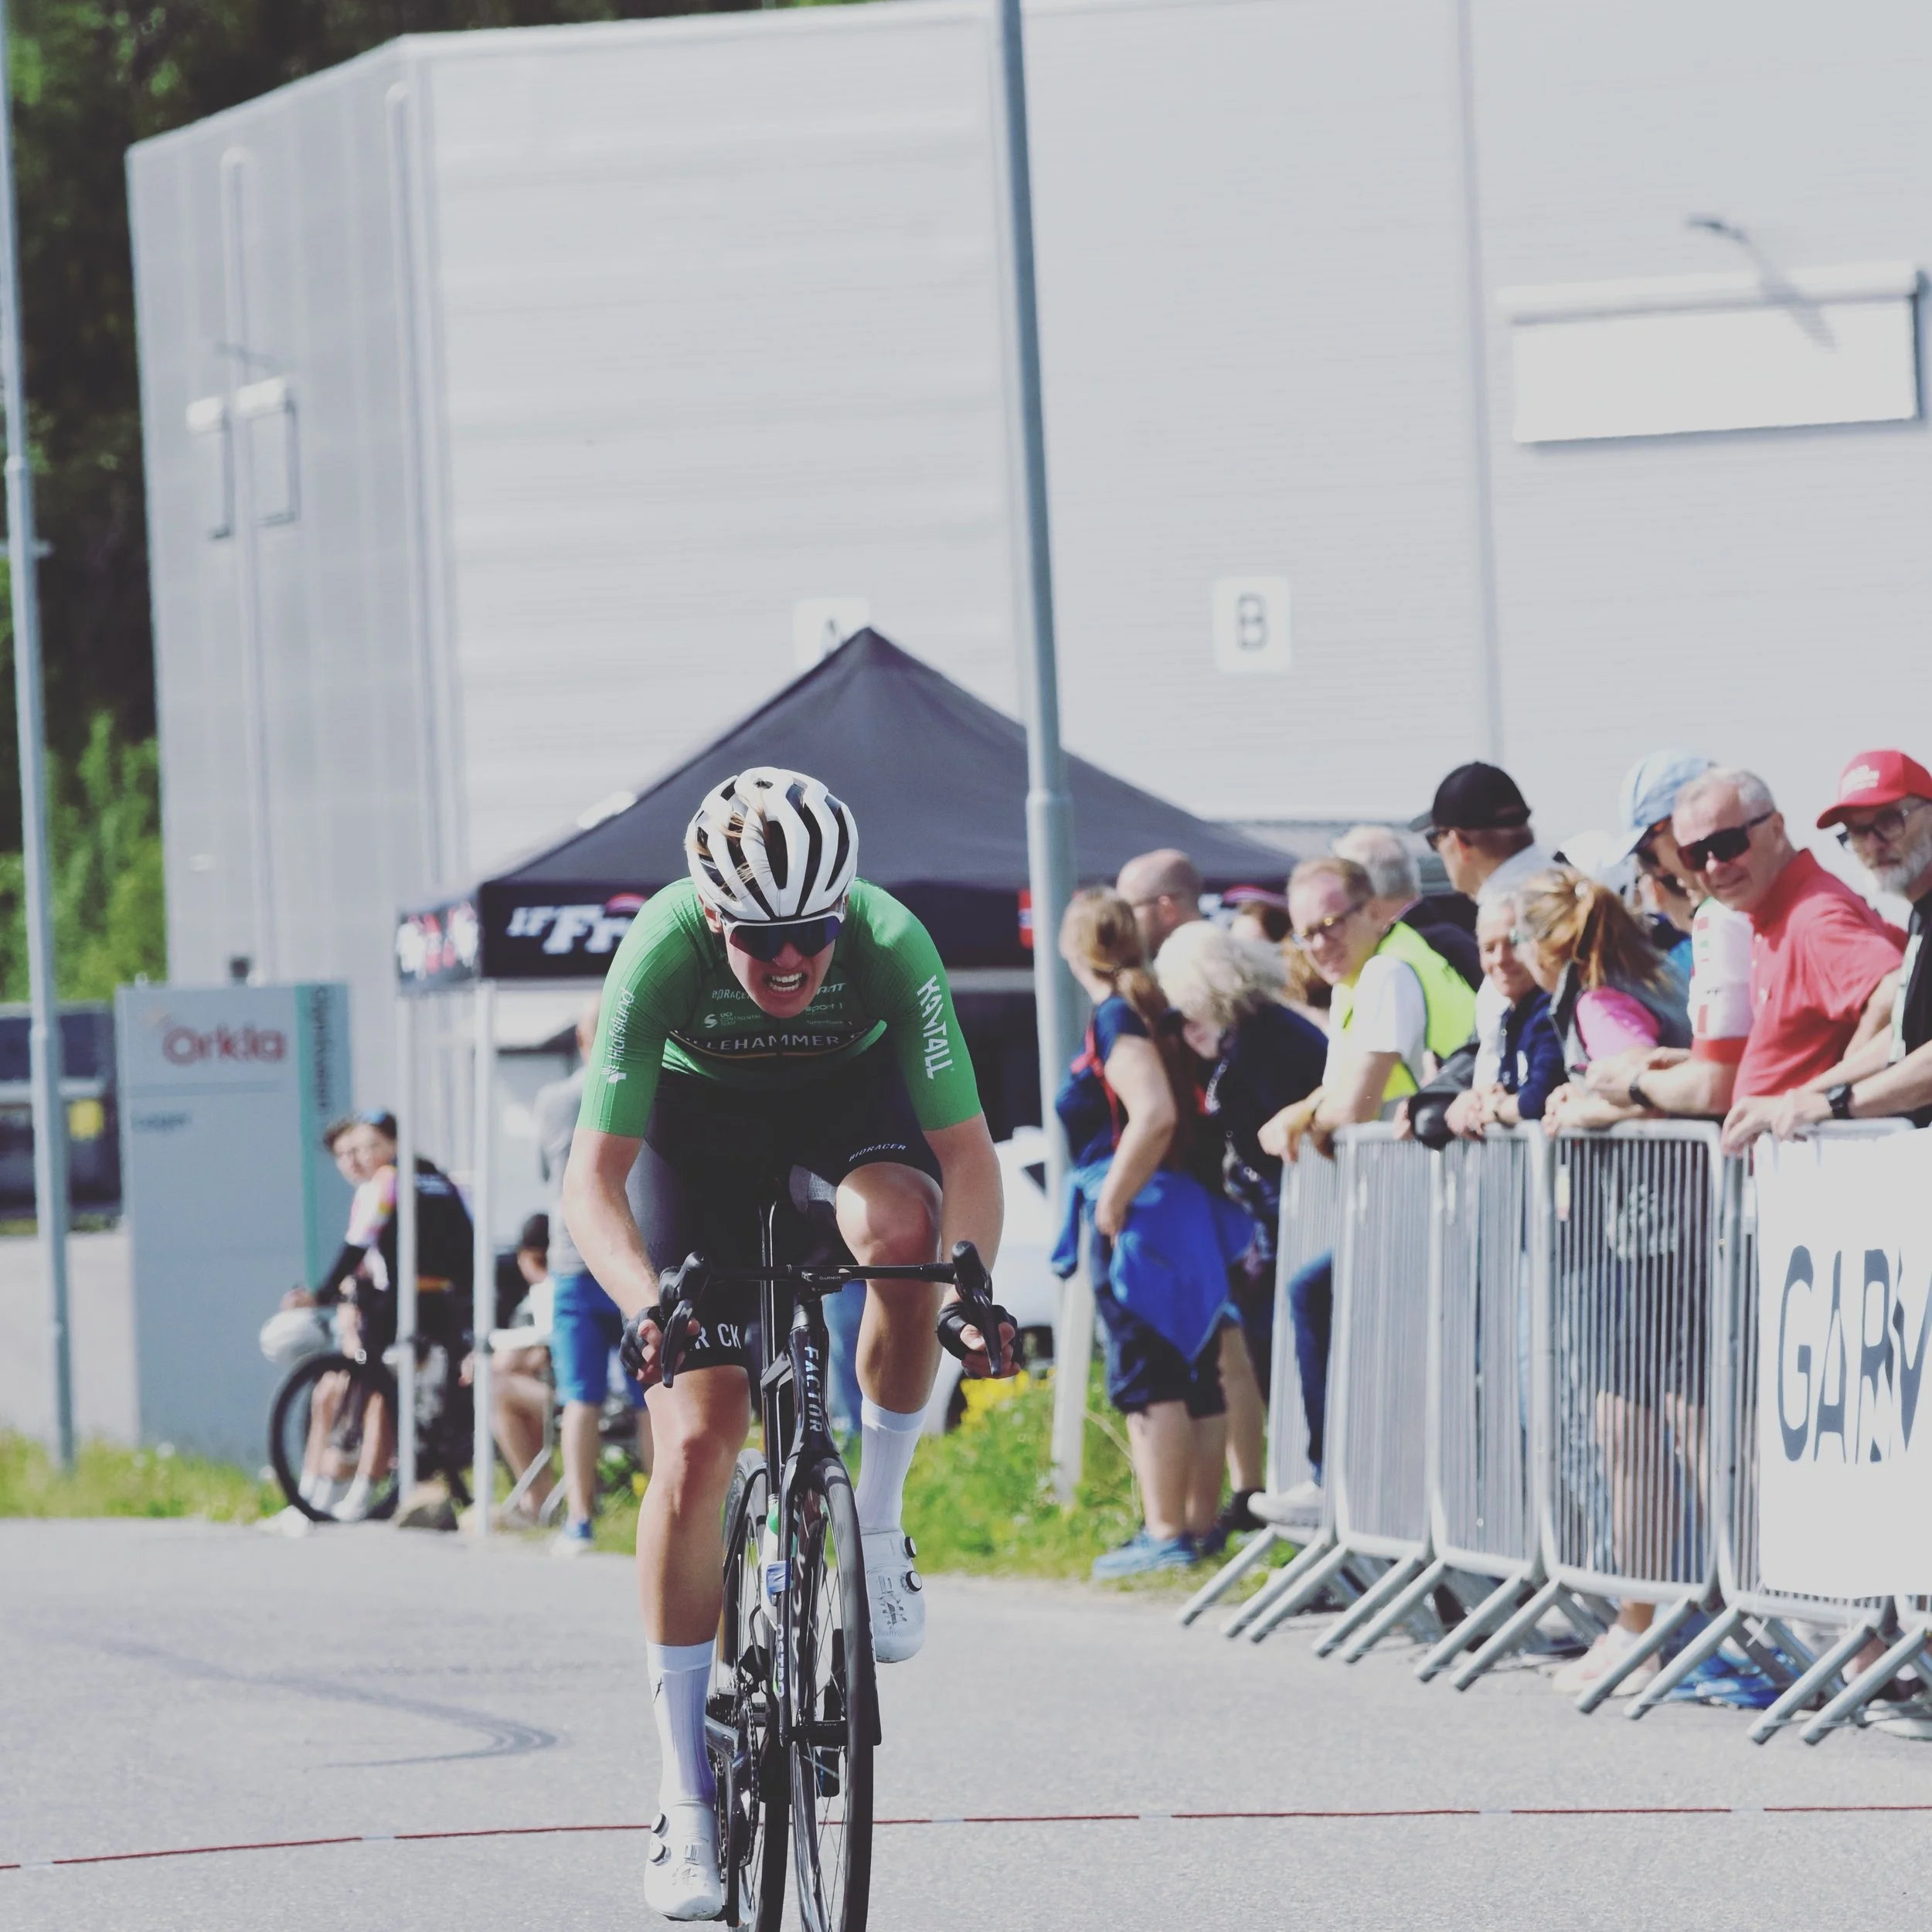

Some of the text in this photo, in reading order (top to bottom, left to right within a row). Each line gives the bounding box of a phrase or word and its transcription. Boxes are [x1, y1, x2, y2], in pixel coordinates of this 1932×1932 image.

[1237, 593, 1268, 651] B
[849, 1143, 906, 1162] BIORACER
[717, 1323, 742, 1349] CK
[804, 1346, 823, 1432] FACTOR
